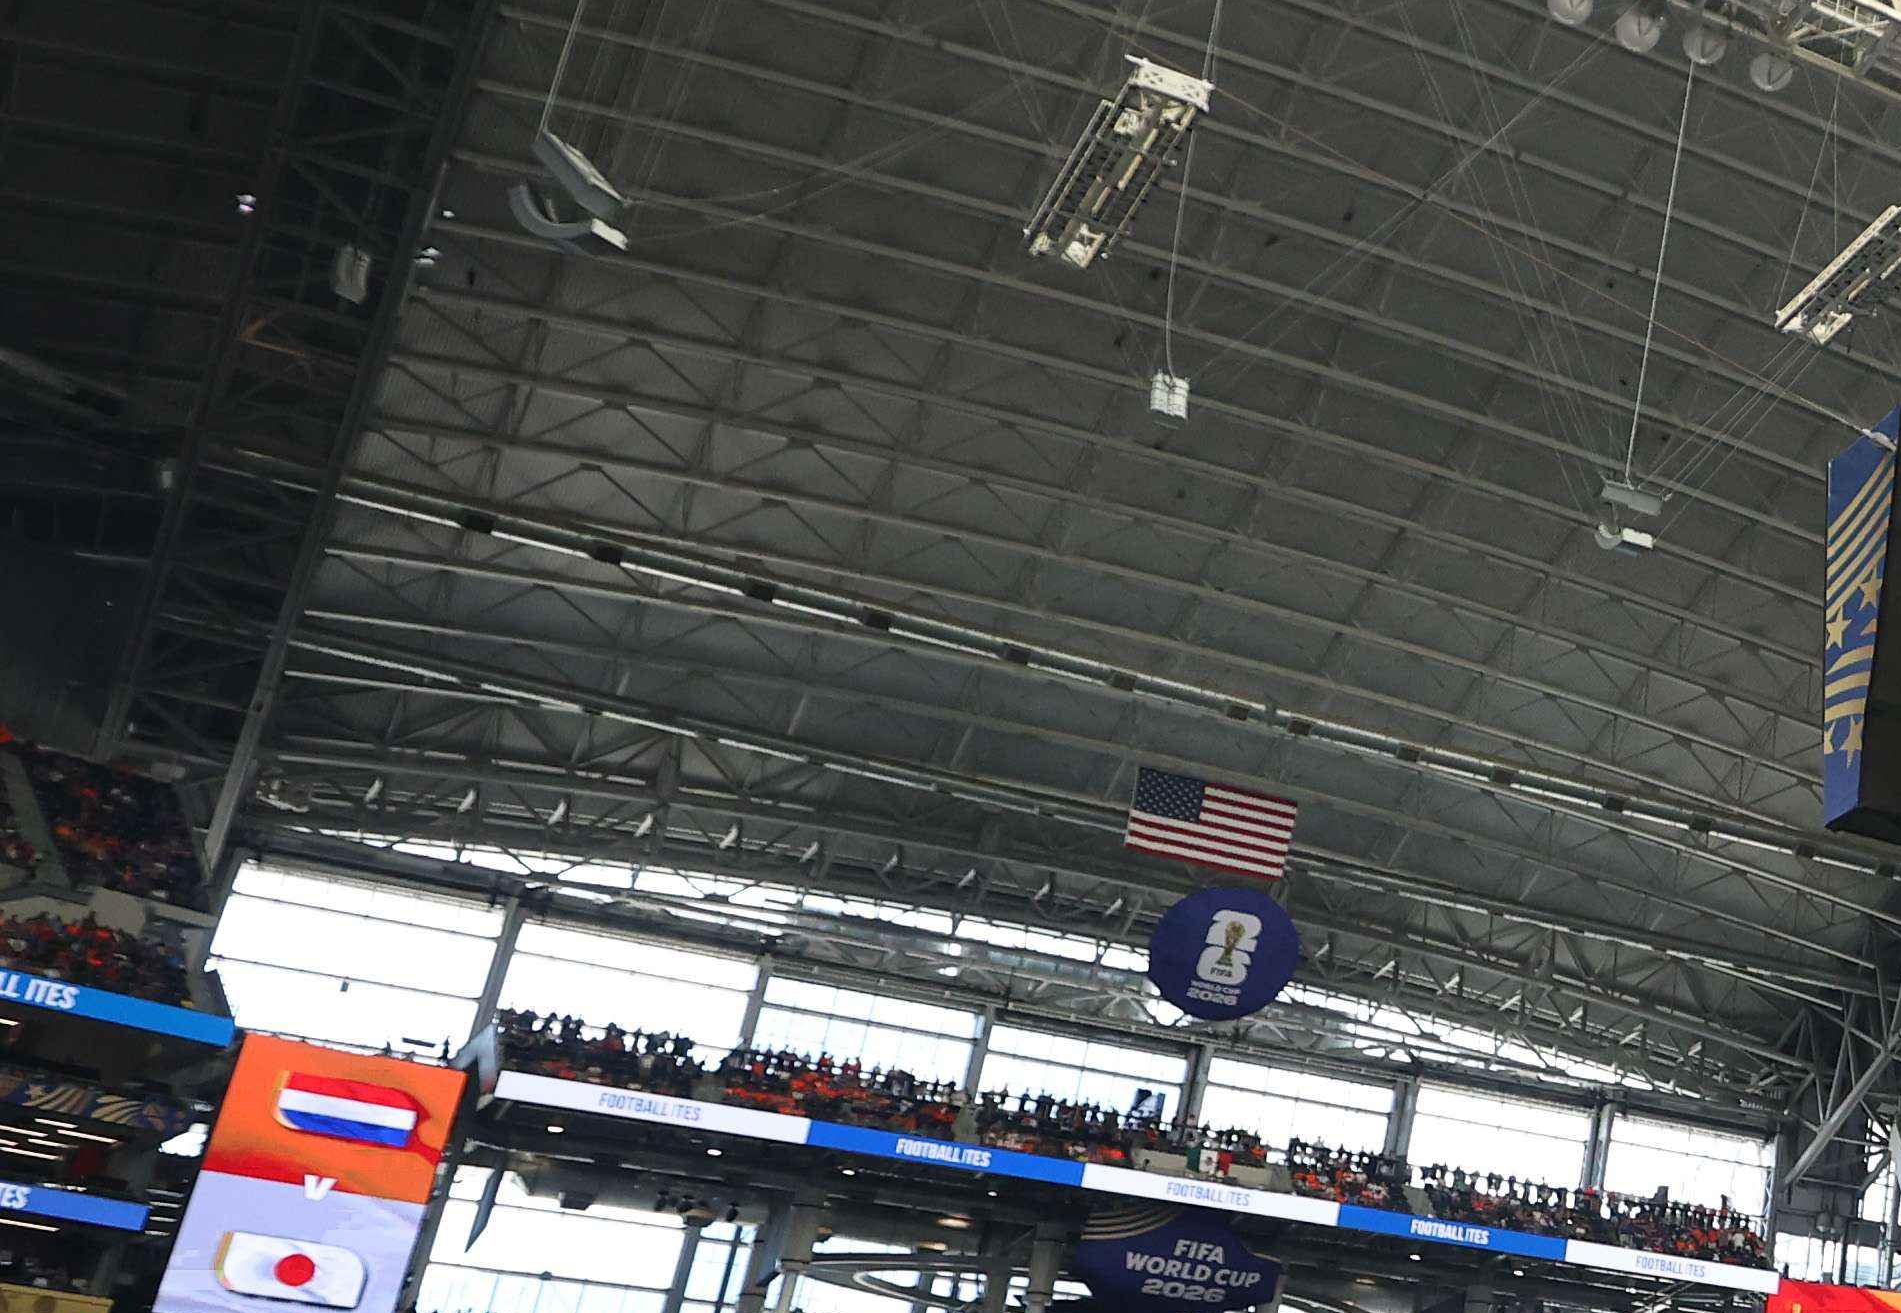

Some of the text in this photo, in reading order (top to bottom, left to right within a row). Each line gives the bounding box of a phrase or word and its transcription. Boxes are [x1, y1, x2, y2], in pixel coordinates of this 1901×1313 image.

[600, 1093, 667, 1117] FOOTBALL
[896, 1138, 960, 1162] FOOTBALL
[1167, 1181, 1225, 1204] FOOTBALL
[1411, 1218, 1464, 1241] FOOTBALL
[1174, 1239, 1225, 1264] FIFA
[1636, 1254, 1681, 1273] FOOTBALL
[1126, 1251, 1261, 1288] WORLD CUP
[1142, 1278, 1226, 1302] 2026
